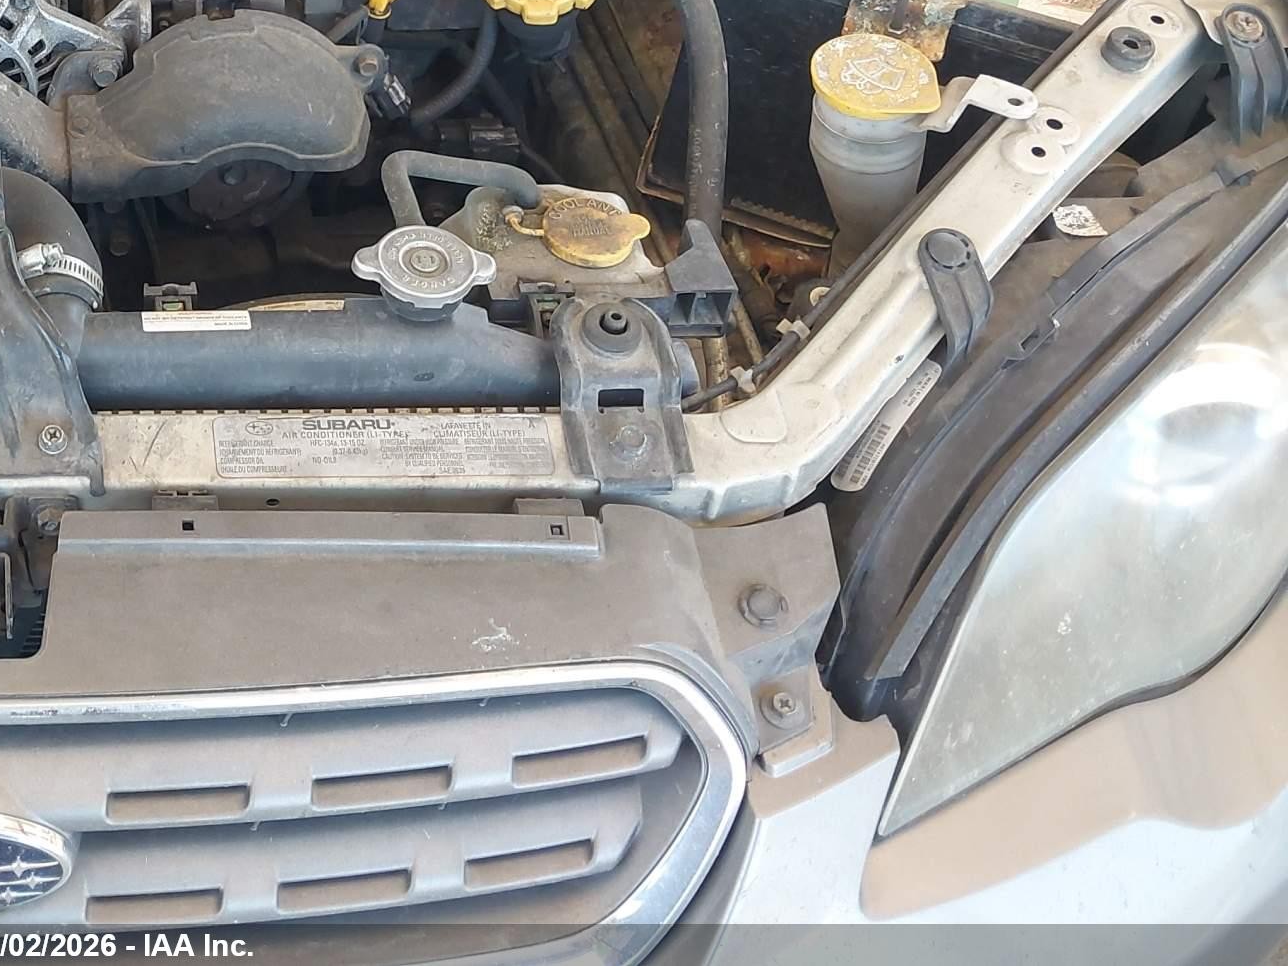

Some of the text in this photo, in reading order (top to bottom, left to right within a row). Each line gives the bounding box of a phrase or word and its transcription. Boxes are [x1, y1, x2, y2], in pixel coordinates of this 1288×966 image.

[302, 419, 392, 431] SUBARU
[300, 431, 366, 439] CONDITIONER
[433, 430, 487, 438] CLIMATISEUR
